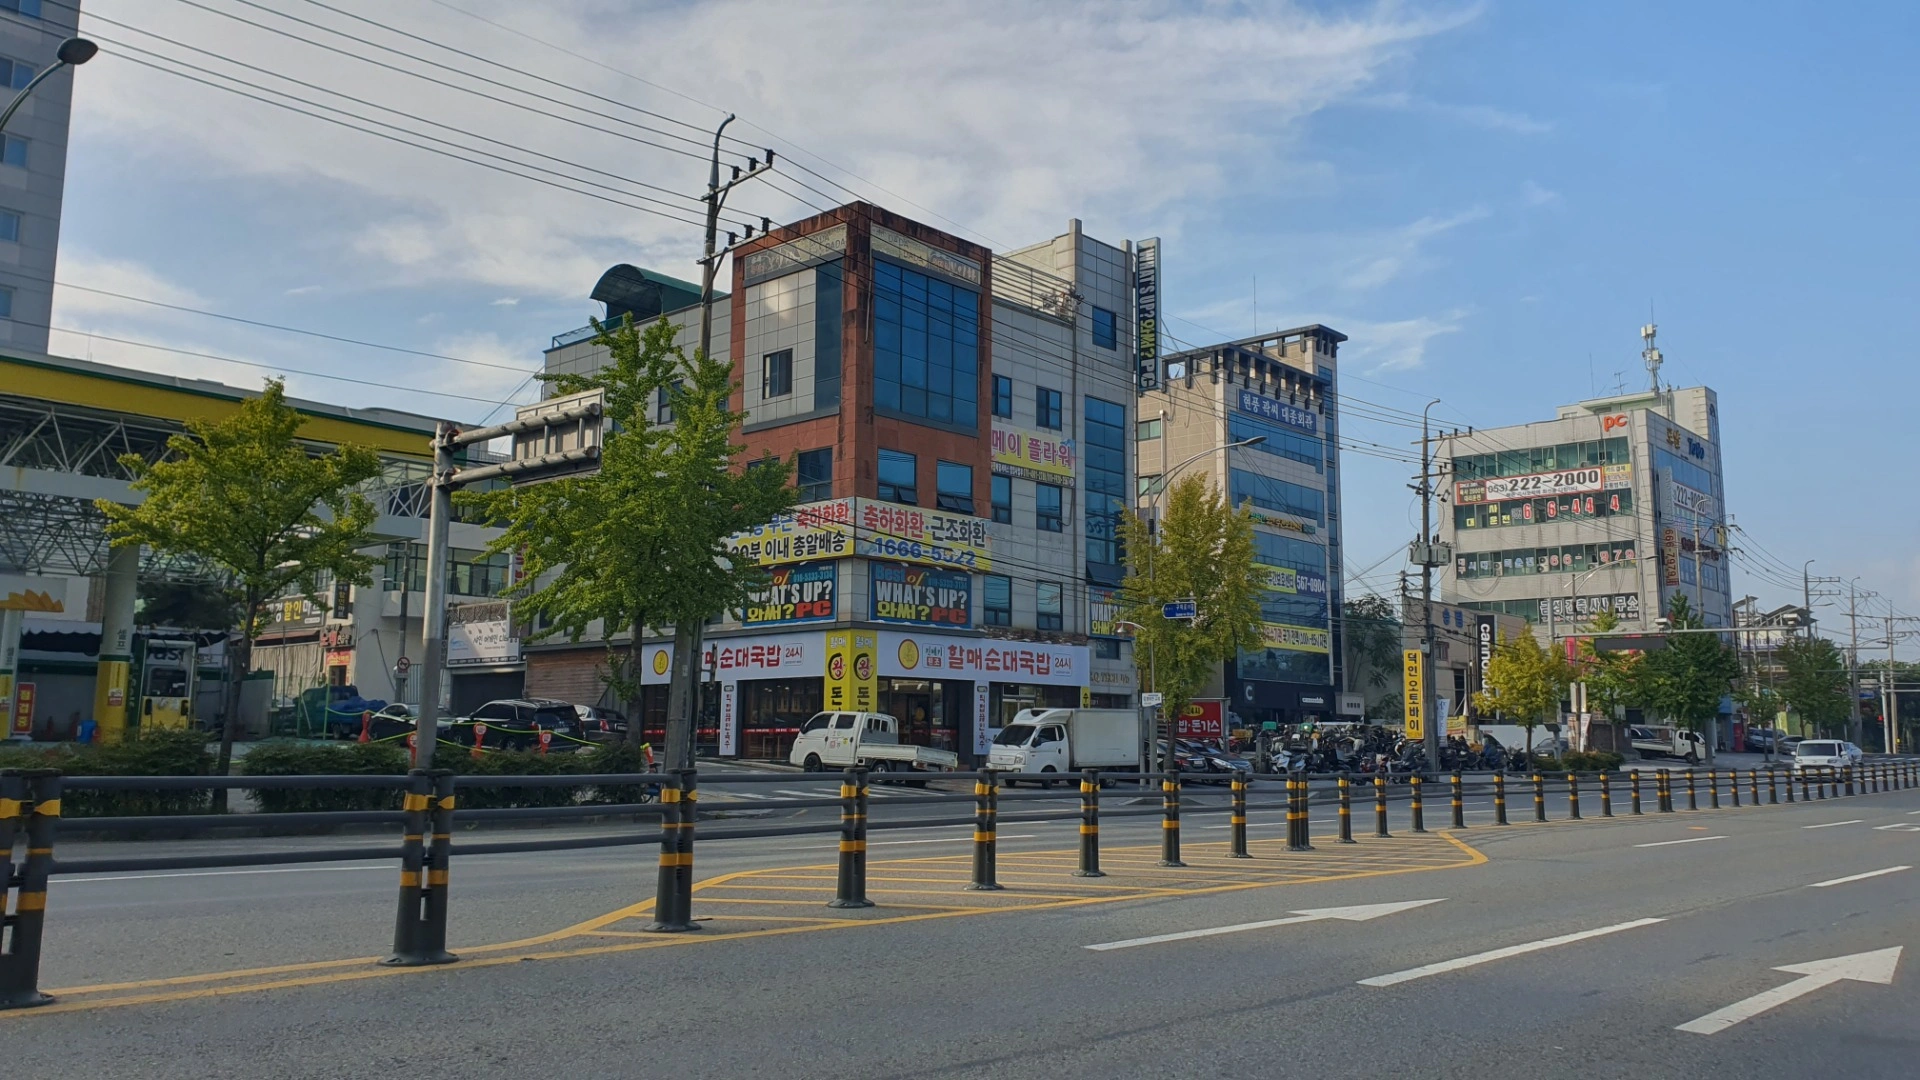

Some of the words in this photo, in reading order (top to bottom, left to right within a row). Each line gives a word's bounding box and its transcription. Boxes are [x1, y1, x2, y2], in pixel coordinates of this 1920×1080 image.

[1141, 358, 1156, 388] PC
[1243, 393, 1260, 413] 현풍
[1281, 407, 1313, 430] 대종회관
[1028, 437, 1072, 469] 플라워
[1508, 470, 1599, 491] 222-2000
[797, 502, 850, 529] 축하화환
[765, 537, 789, 560] 이내
[793, 530, 846, 557] 총알배송
[773, 569, 795, 586] of
[876, 564, 906, 582] Best
[907, 571, 930, 587] of
[1296, 574, 1326, 593] 567-0904
[803, 580, 833, 602] UP?
[876, 581, 935, 606] WHAT'S
[938, 588, 968, 609] UP?
[795, 600, 831, 618] PC
[931, 606, 967, 624] PC
[701, 644, 781, 669] 매순대국밥
[785, 646, 803, 658] 24시
[948, 644, 1050, 675] 할매순대국밥
[1055, 657, 1071, 669] 24시
[1407, 653, 1419, 731] 덕인오토바이
[1176, 720, 1220, 733] 밥·돈가스
